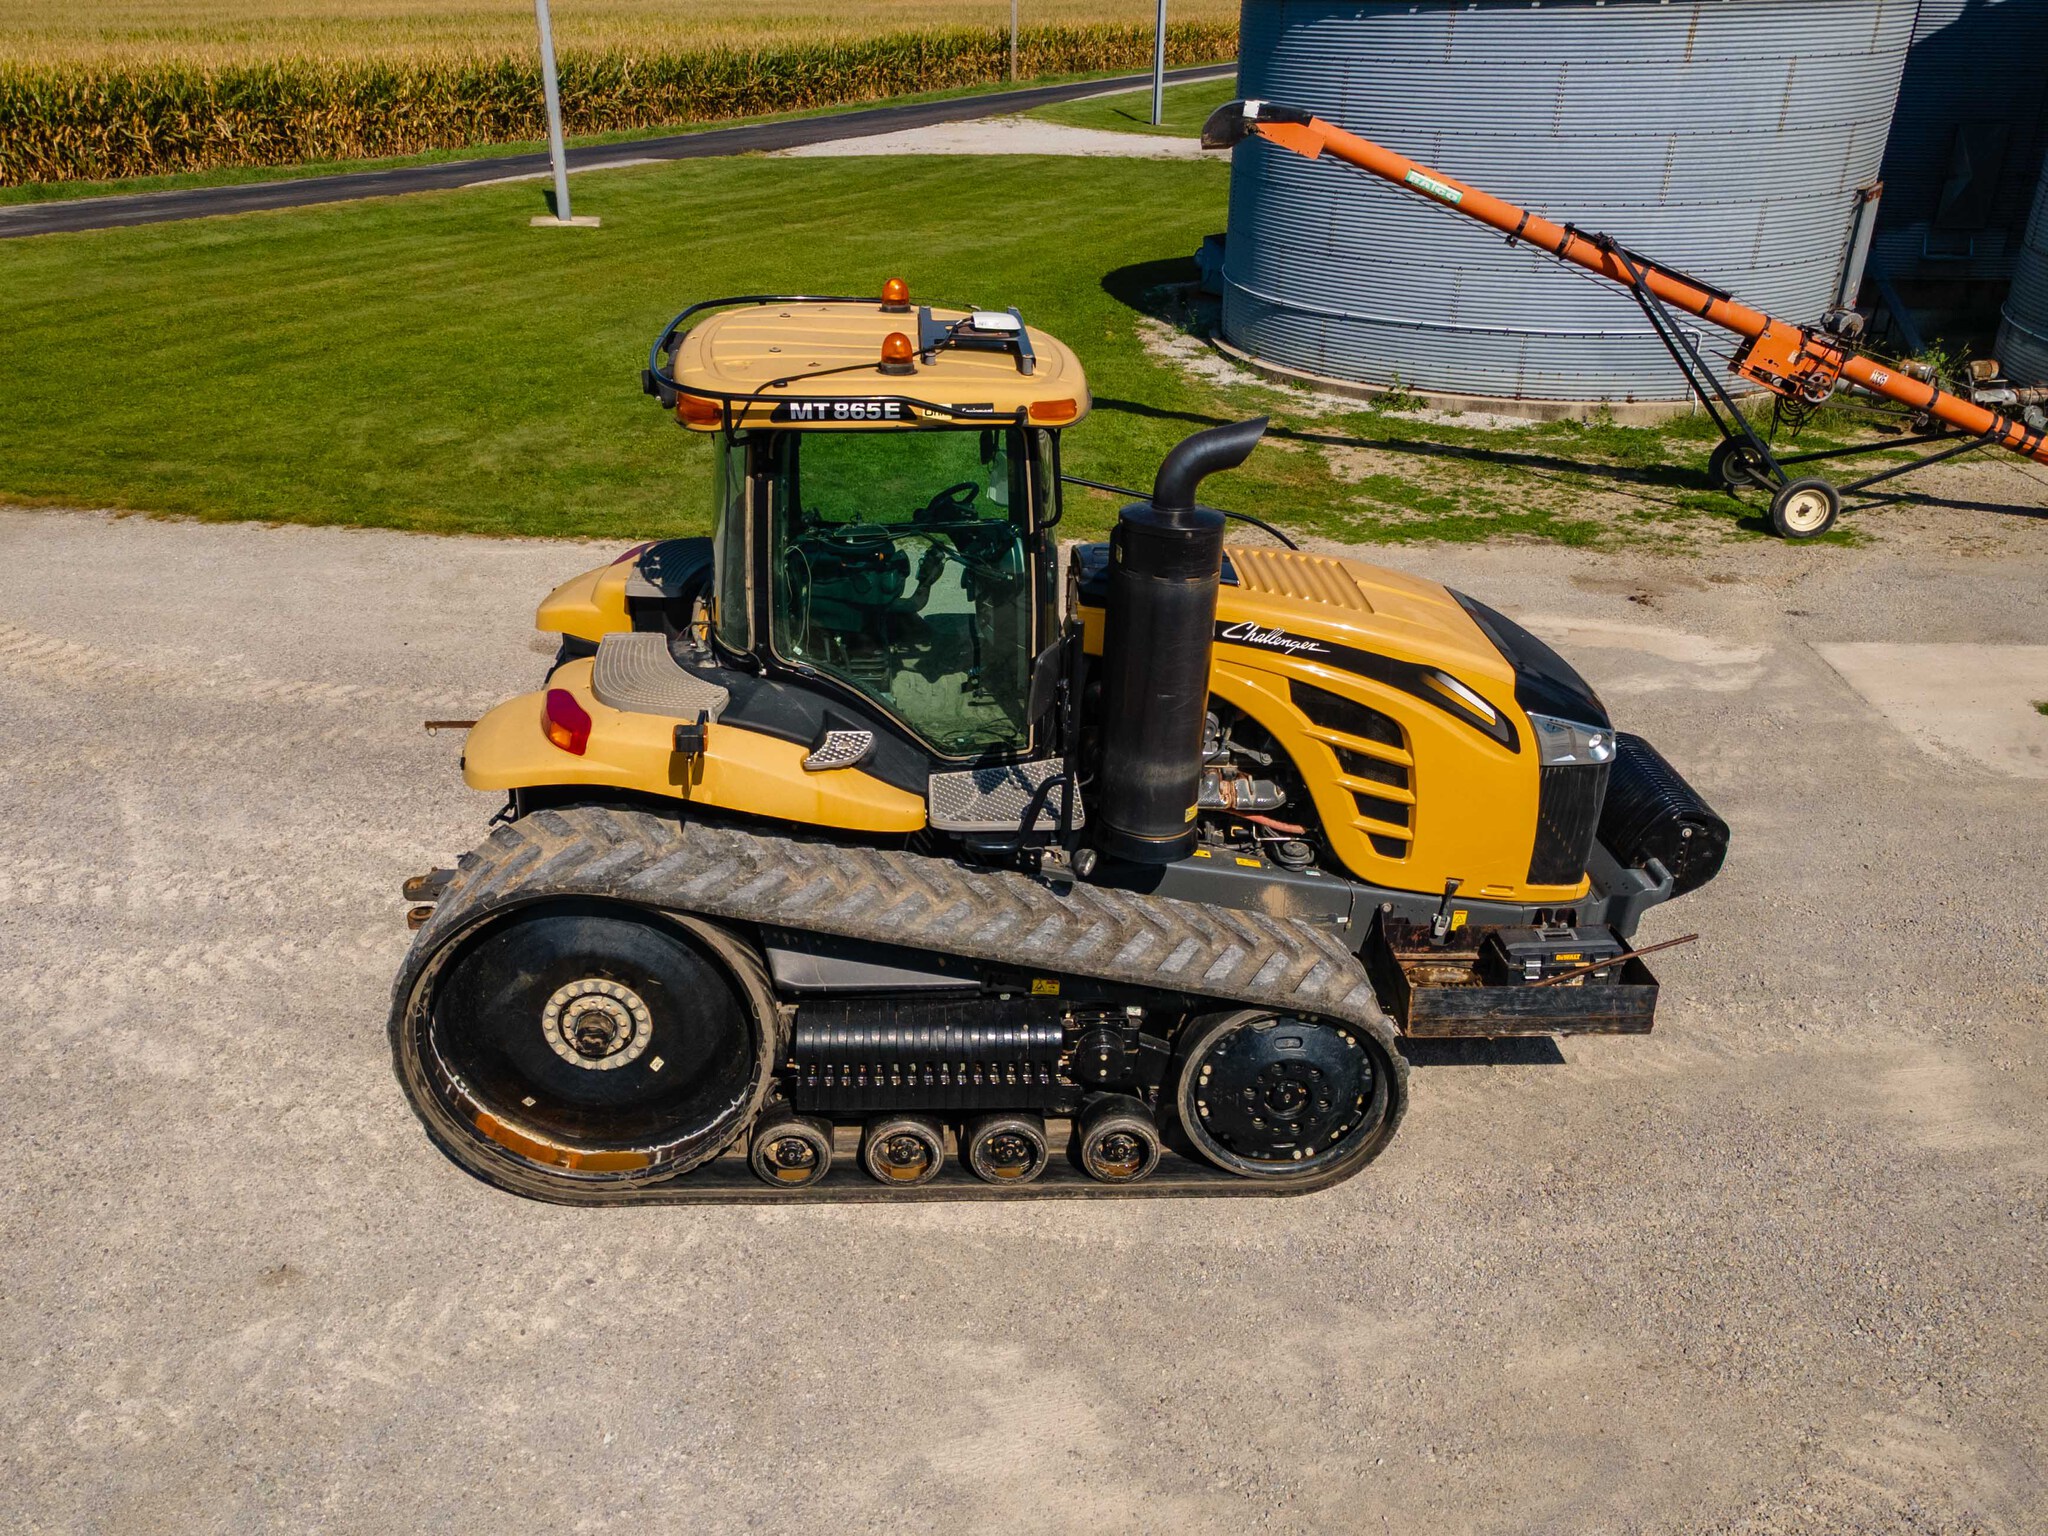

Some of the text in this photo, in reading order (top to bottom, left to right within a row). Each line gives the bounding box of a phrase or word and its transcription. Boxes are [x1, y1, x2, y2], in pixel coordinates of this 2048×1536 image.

[1408, 174, 1460, 202] BATCO
[789, 402, 830, 420] MT
[1221, 621, 1331, 655] Challenger
